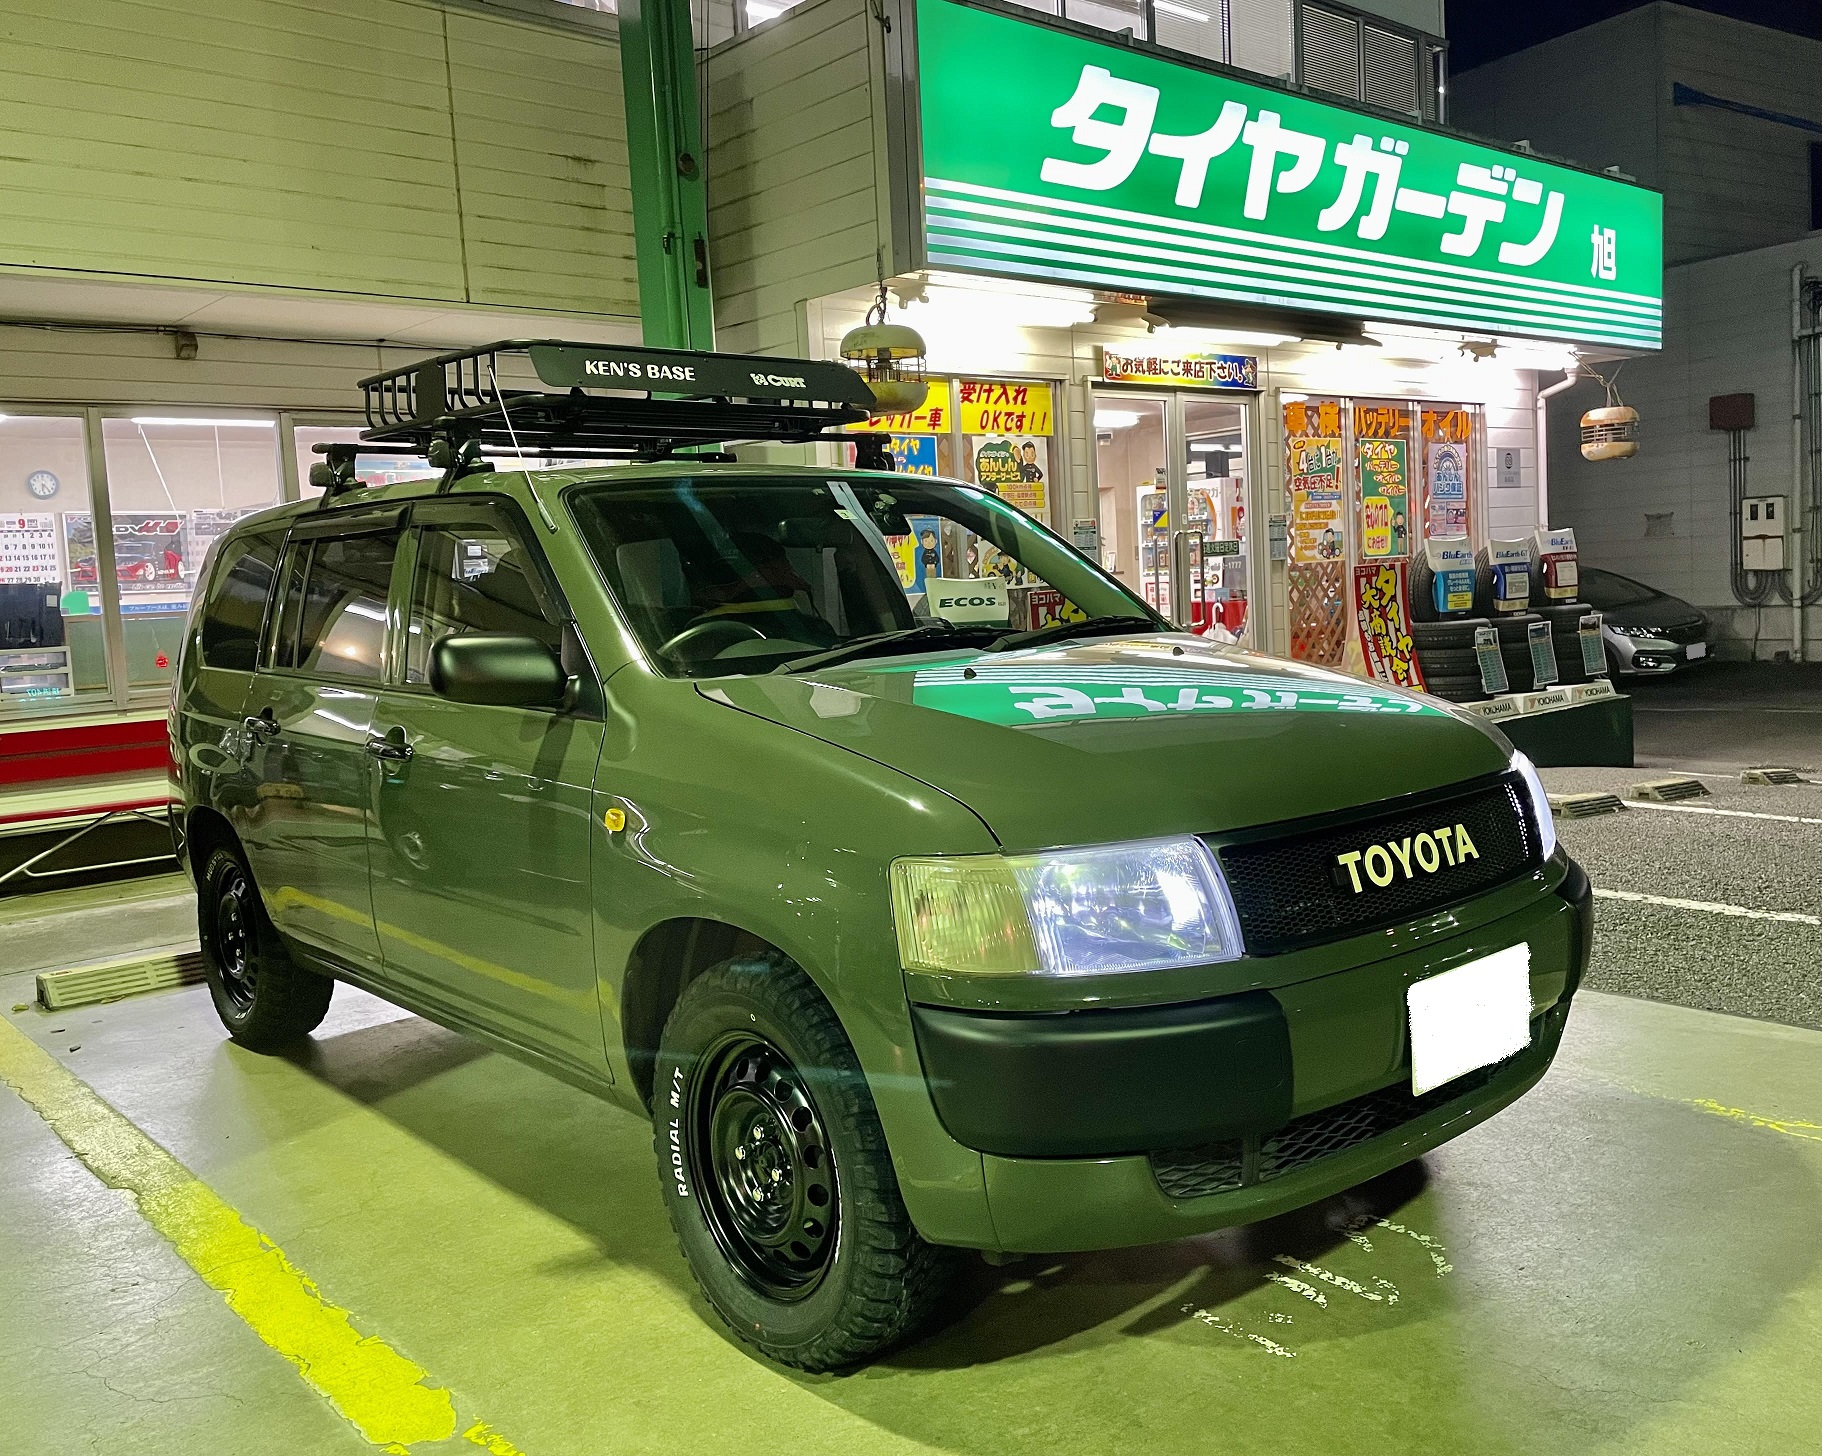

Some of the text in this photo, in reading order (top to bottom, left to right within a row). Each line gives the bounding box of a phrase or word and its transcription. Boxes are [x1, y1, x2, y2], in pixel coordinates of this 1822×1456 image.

[1040, 64, 1617, 282] タイヤガーデン 旭
[585, 360, 696, 382] KEN'S BASE
[1121, 356, 1244, 383] お気軽にご来店下さい。
[959, 382, 1028, 406] 受け入れ
[1285, 400, 1342, 436] 車検
[1353, 405, 1411, 438] バッテリー
[1421, 408, 1473, 440] オイル
[1364, 441, 1397, 459] タイヤ
[979, 457, 1018, 472] あんしん
[18, 518, 26, 529] 9
[1442, 550, 1473, 560] BluEarth
[938, 596, 997, 609] ECOS
[1031, 593, 1063, 605] ヨコハマ
[1375, 564, 1414, 660] タイヤ
[1536, 693, 1565, 707] YOKOHAMA
[1585, 685, 1611, 697] YOKOHAMA
[1482, 703, 1512, 716] YOKOHAMA
[1337, 823, 1480, 894] TOYOTA
[669, 1066, 689, 1197] RADIAL M/T
